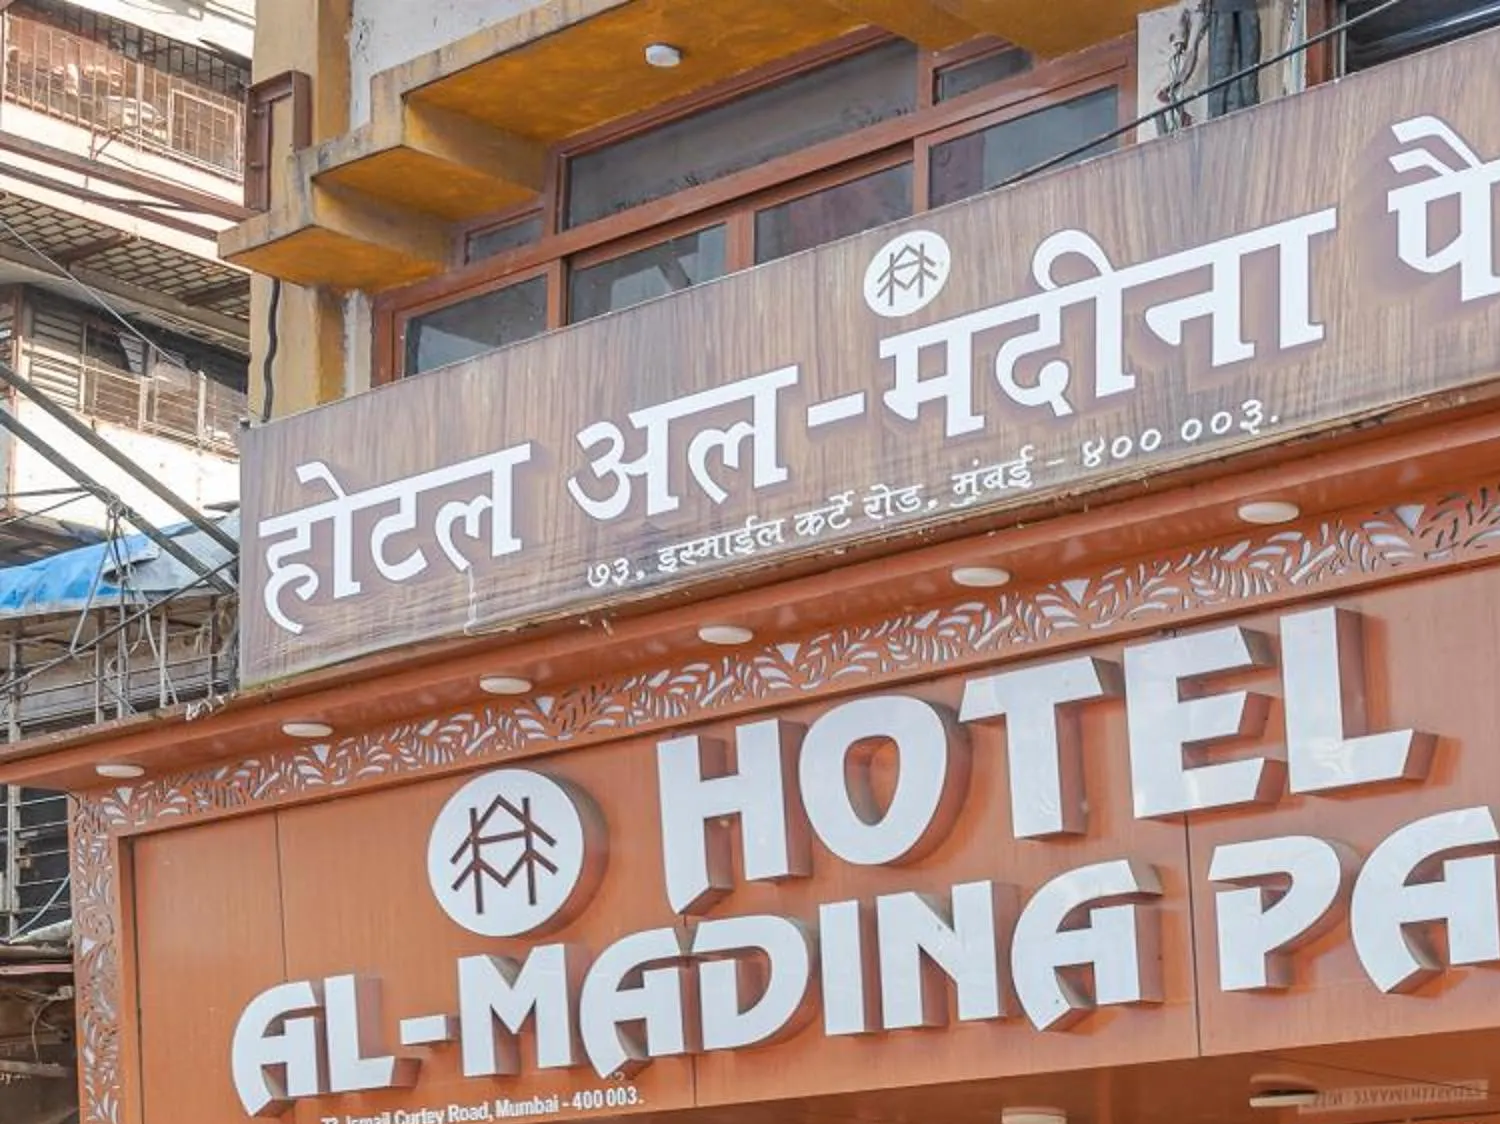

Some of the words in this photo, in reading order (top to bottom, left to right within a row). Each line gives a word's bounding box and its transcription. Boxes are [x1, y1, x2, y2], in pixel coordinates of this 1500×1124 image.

[258, 442, 531, 634] होटल
[657, 515, 786, 573] इस्माईल
[951, 444, 1033, 507] मुंबई
[1081, 439, 1162, 468] ४००
[656, 606, 1416, 914] HOTEL
[231, 859, 1142, 1116] AL-MADINA
[447, 1101, 493, 1123] Road,
[495, 1094, 559, 1118] Mumbai
[572, 1091, 603, 1111] 400
[605, 1086, 645, 1107] 003.
